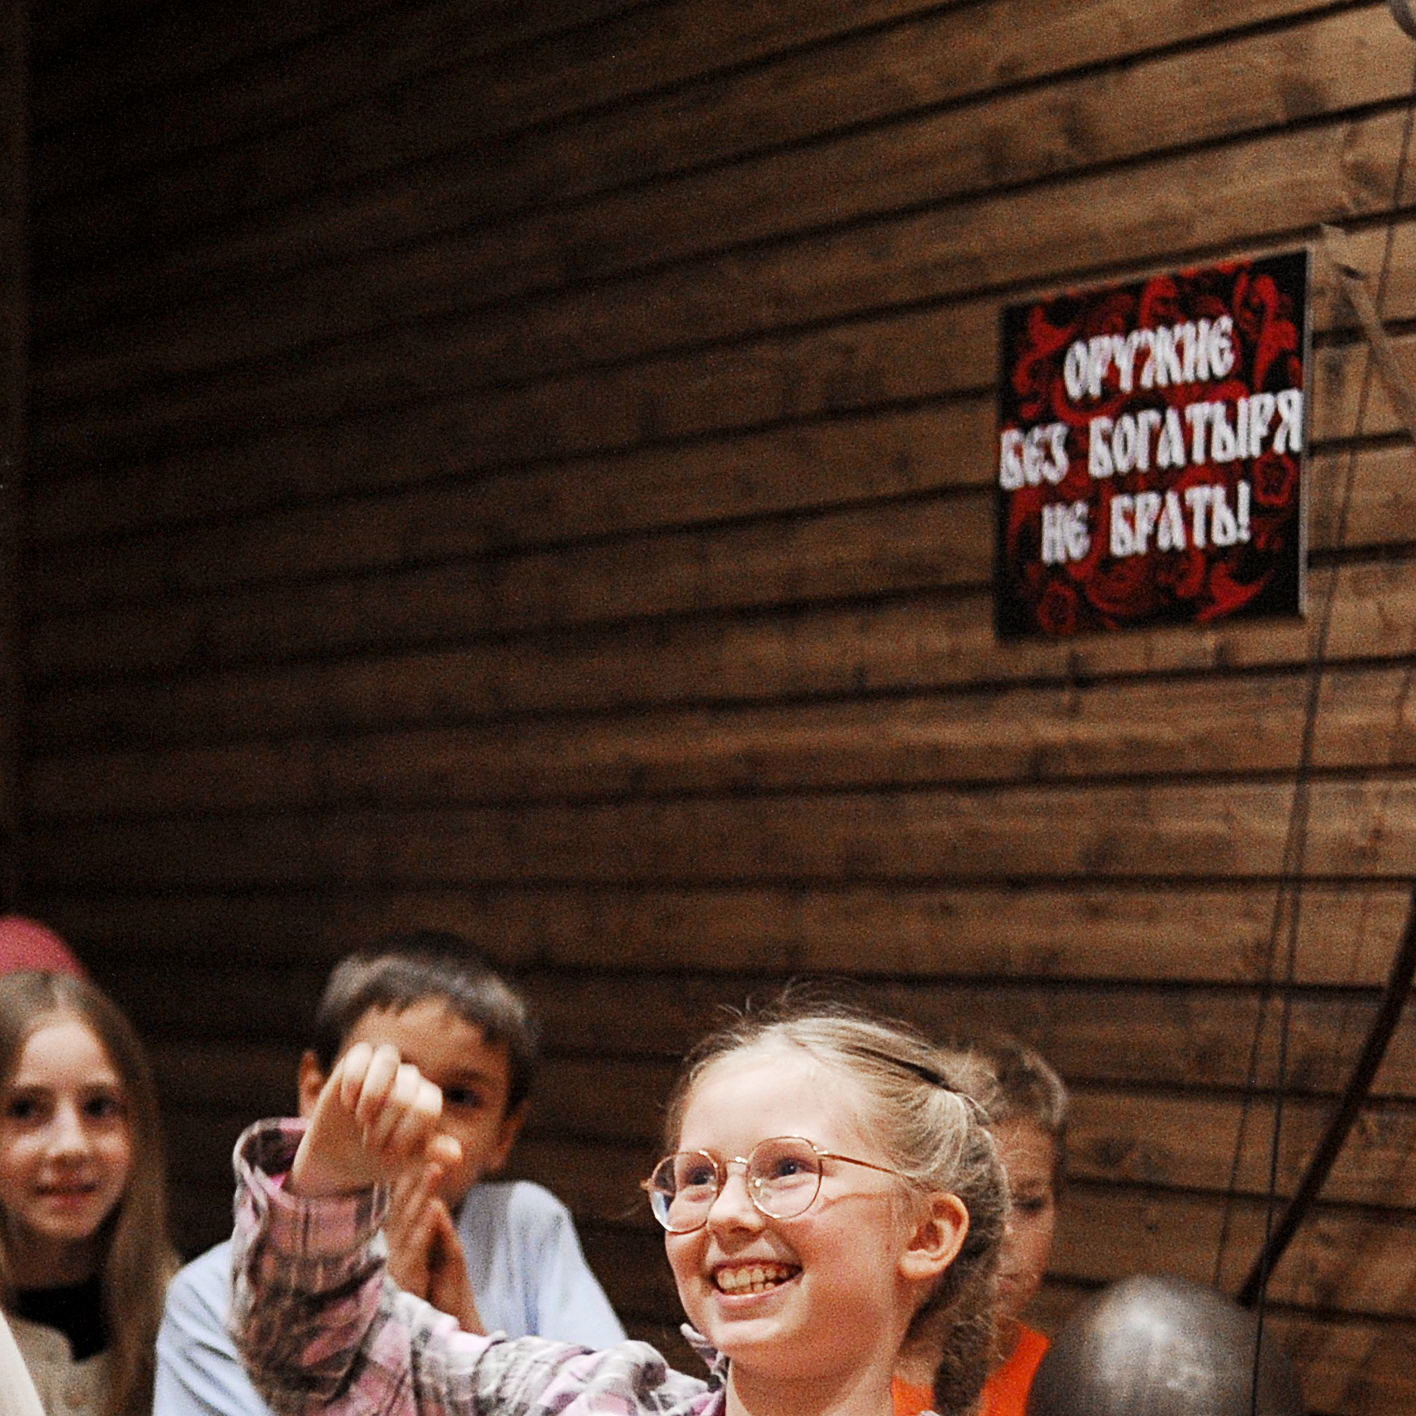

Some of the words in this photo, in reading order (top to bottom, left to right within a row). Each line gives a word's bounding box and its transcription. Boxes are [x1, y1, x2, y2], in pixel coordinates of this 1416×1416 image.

[1064, 316, 1234, 400] ОРУЖИЕ
[999, 422, 1069, 491] БЕЗ
[1088, 388, 1305, 479] БОГАТЫРЯ
[1041, 501, 1090, 565] НЕ
[1109, 480, 1251, 558] БРАТЬ!
